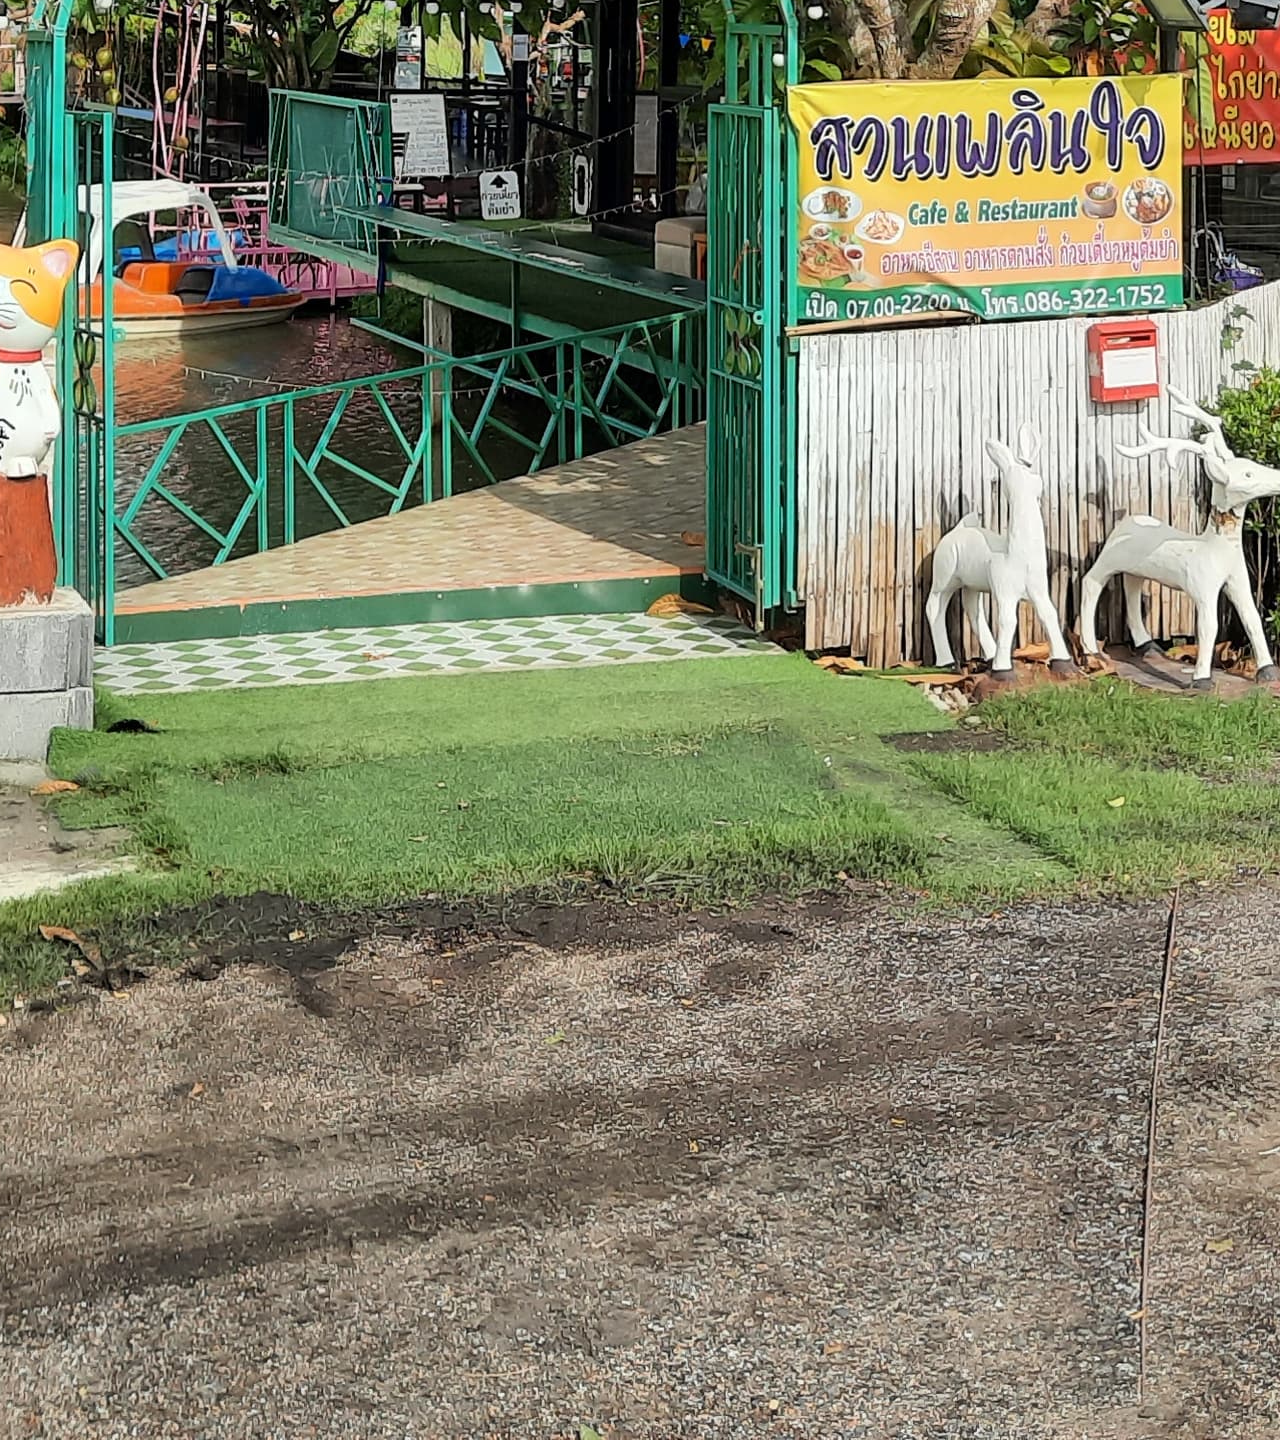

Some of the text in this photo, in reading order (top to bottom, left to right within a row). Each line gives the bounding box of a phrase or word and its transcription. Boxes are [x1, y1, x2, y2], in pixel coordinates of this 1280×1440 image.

[810, 80, 1166, 182] สวนเพลินใจ
[908, 196, 1079, 226] Cafe & Restaurant
[964, 225, 1054, 272] อาหารตามสั่ง
[805, 291, 838, 318] เปิด
